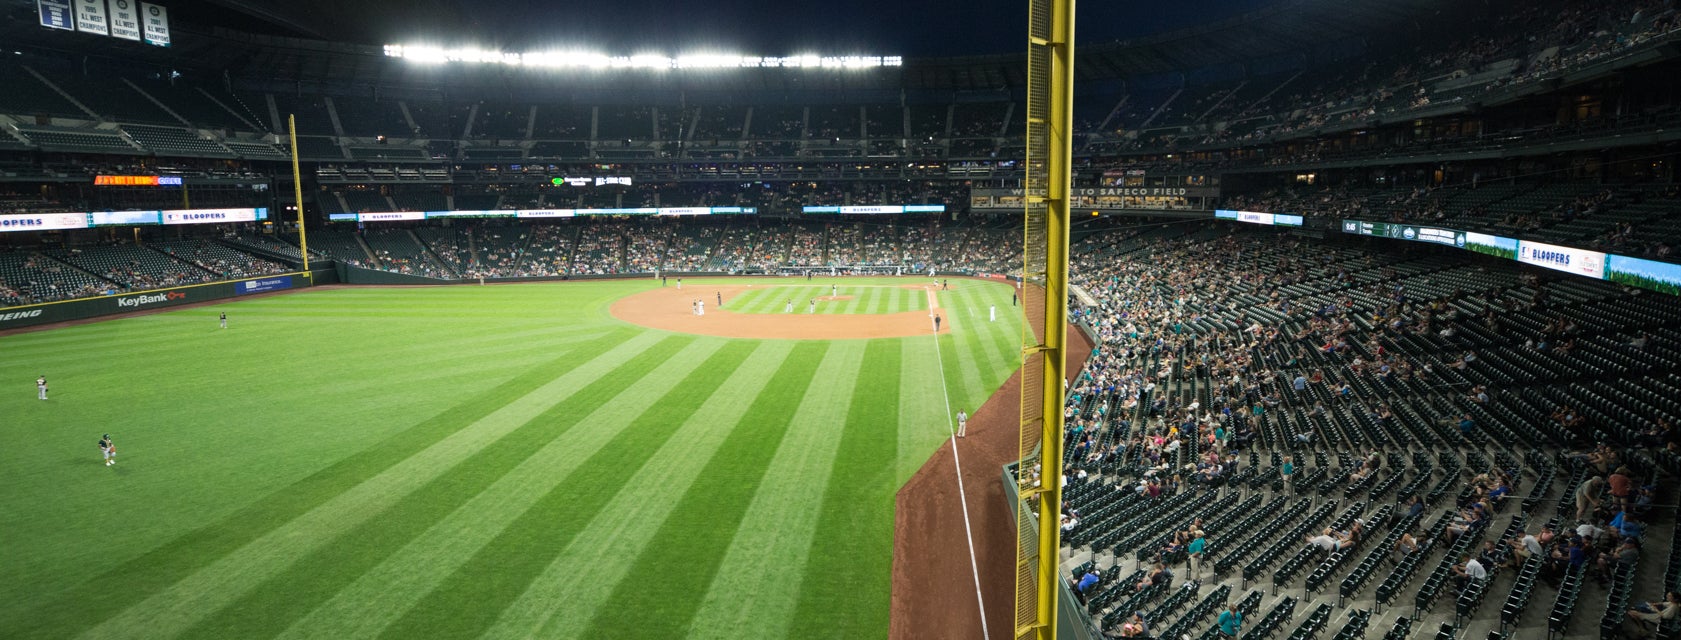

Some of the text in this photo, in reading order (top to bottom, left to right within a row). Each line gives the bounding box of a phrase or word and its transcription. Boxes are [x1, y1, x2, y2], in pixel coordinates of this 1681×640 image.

[79, 22, 106, 32] CHAMPIONS
[1080, 188, 1095, 196] TO
[1100, 188, 1148, 196] SAFECO
[1154, 188, 1186, 196] FIELD
[1532, 249, 1571, 265] BLOOPERS
[118, 293, 168, 308] KeyBank
